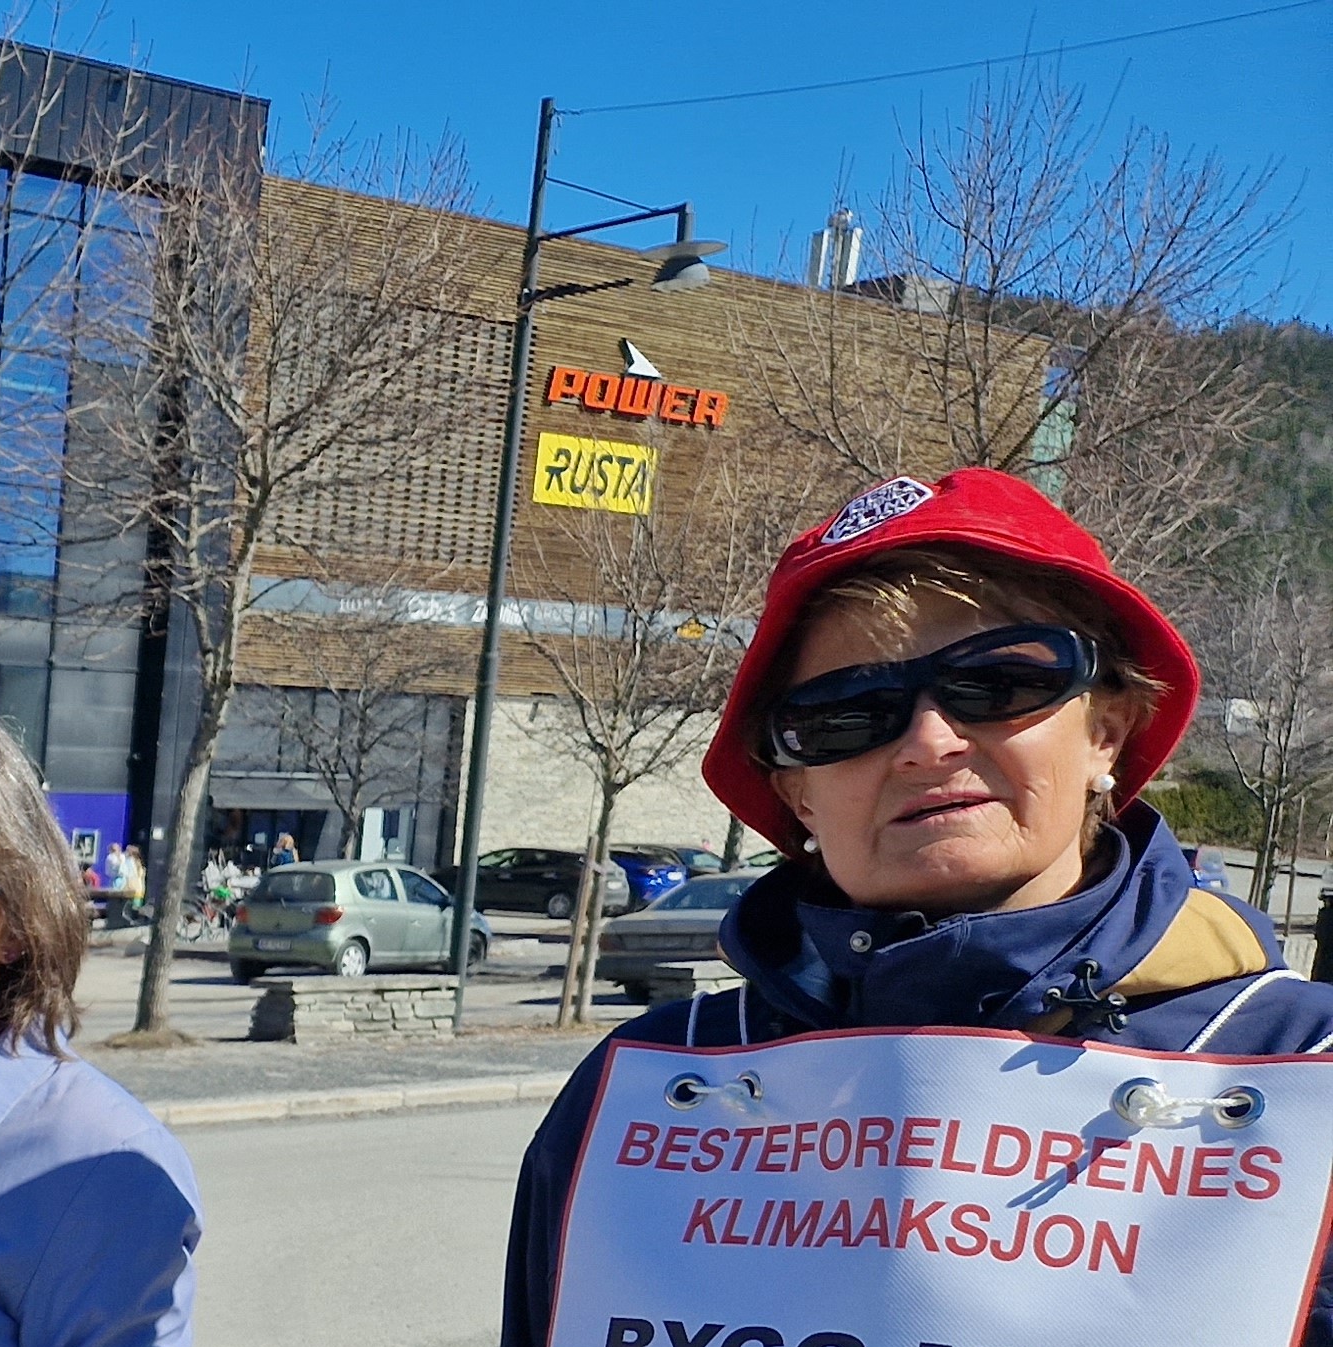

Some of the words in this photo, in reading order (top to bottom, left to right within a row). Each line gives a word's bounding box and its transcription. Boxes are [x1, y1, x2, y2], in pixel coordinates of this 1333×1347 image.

[546, 365, 731, 428] POWER
[544, 447, 648, 501] RUSTA
[617, 1117, 1282, 1200] BESTEFORELDRENES
[681, 1198, 1140, 1275] KLIMAAKSJON
